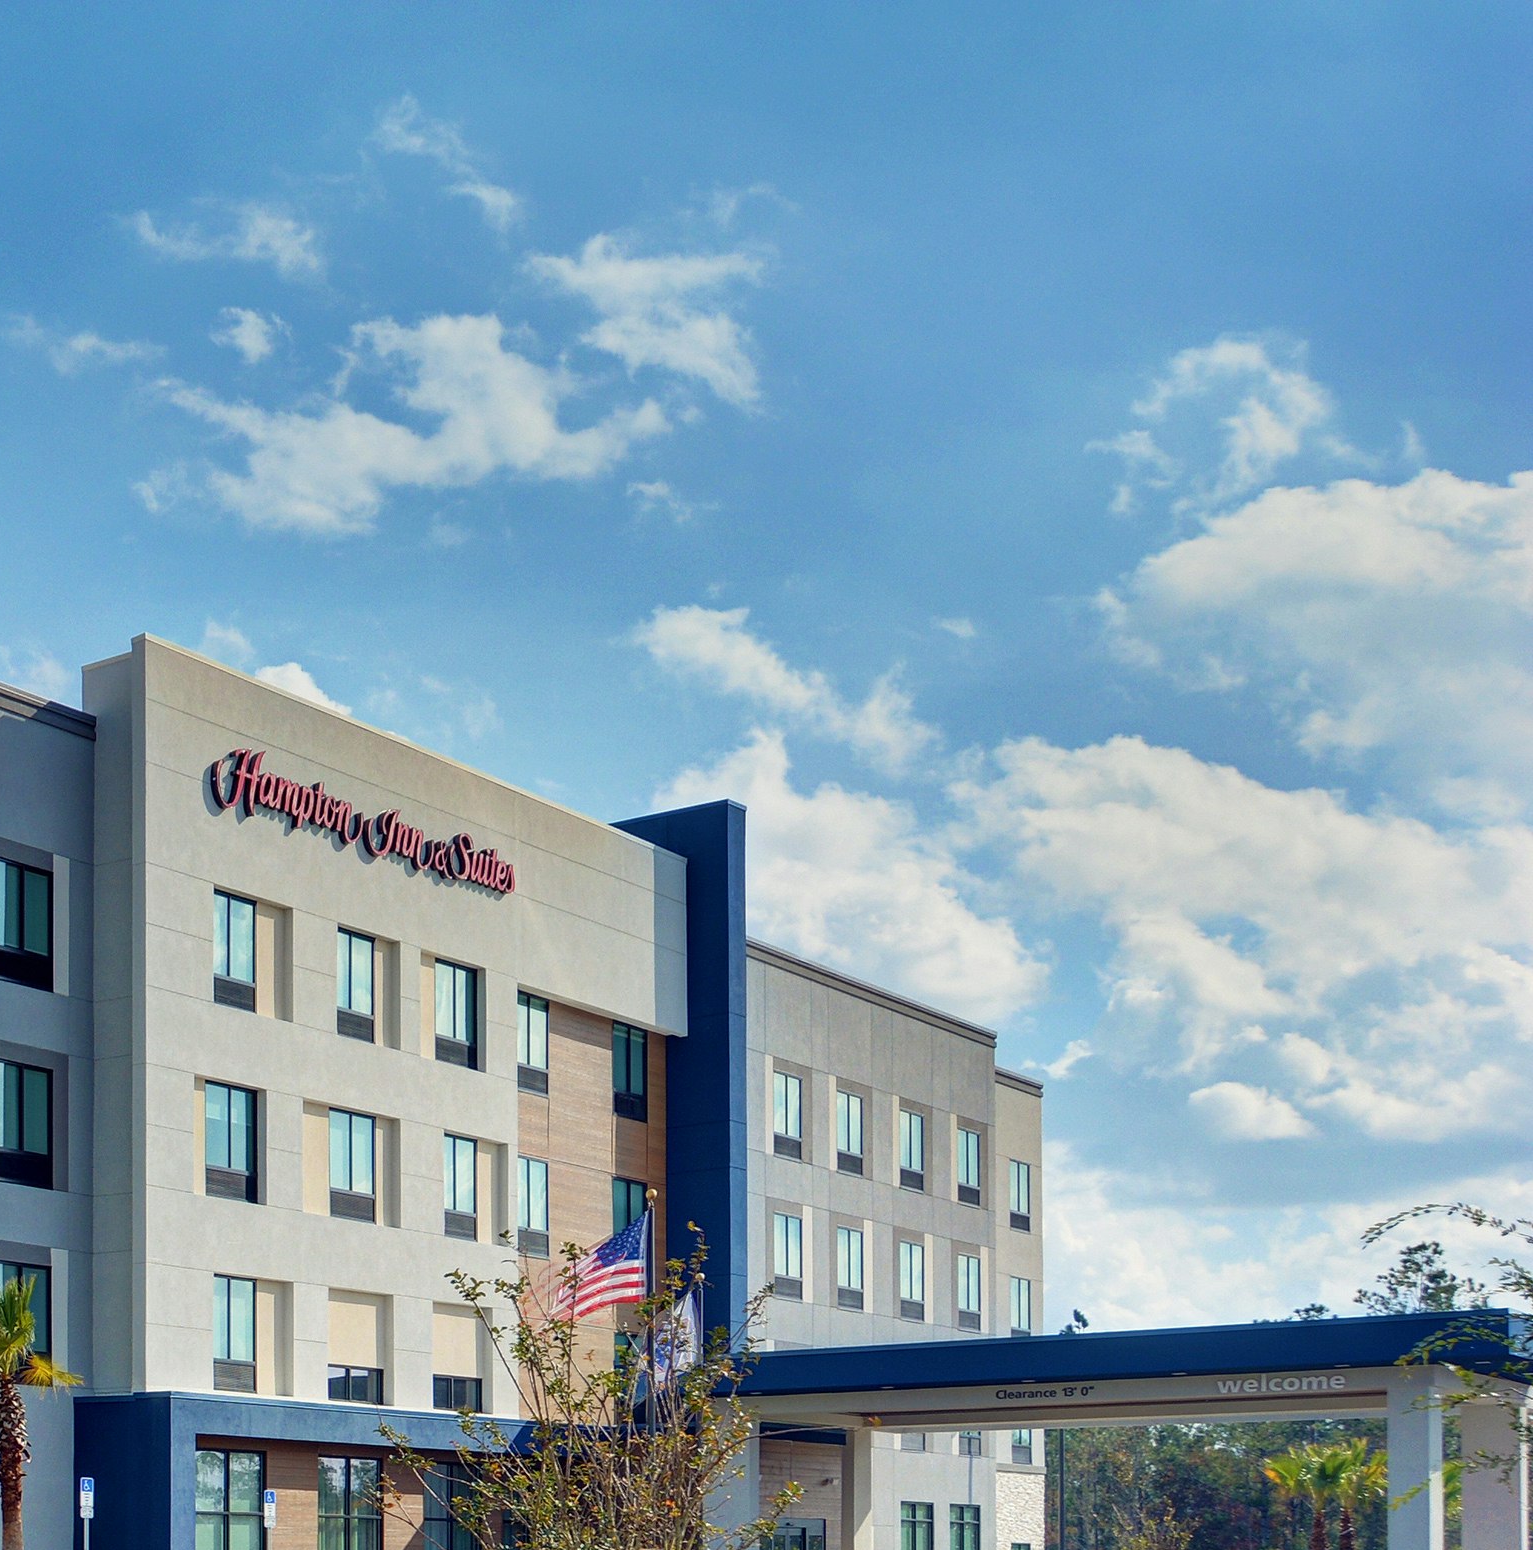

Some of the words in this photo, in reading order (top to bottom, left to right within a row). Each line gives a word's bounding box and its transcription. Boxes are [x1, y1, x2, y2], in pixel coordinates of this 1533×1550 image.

[210, 748, 363, 844] Hampton
[364, 808, 434, 870] Inn
[434, 840, 454, 879] &
[450, 833, 515, 894] Suites
[1216, 1373, 1346, 1394] welcome
[995, 1389, 1057, 1400] Clearance
